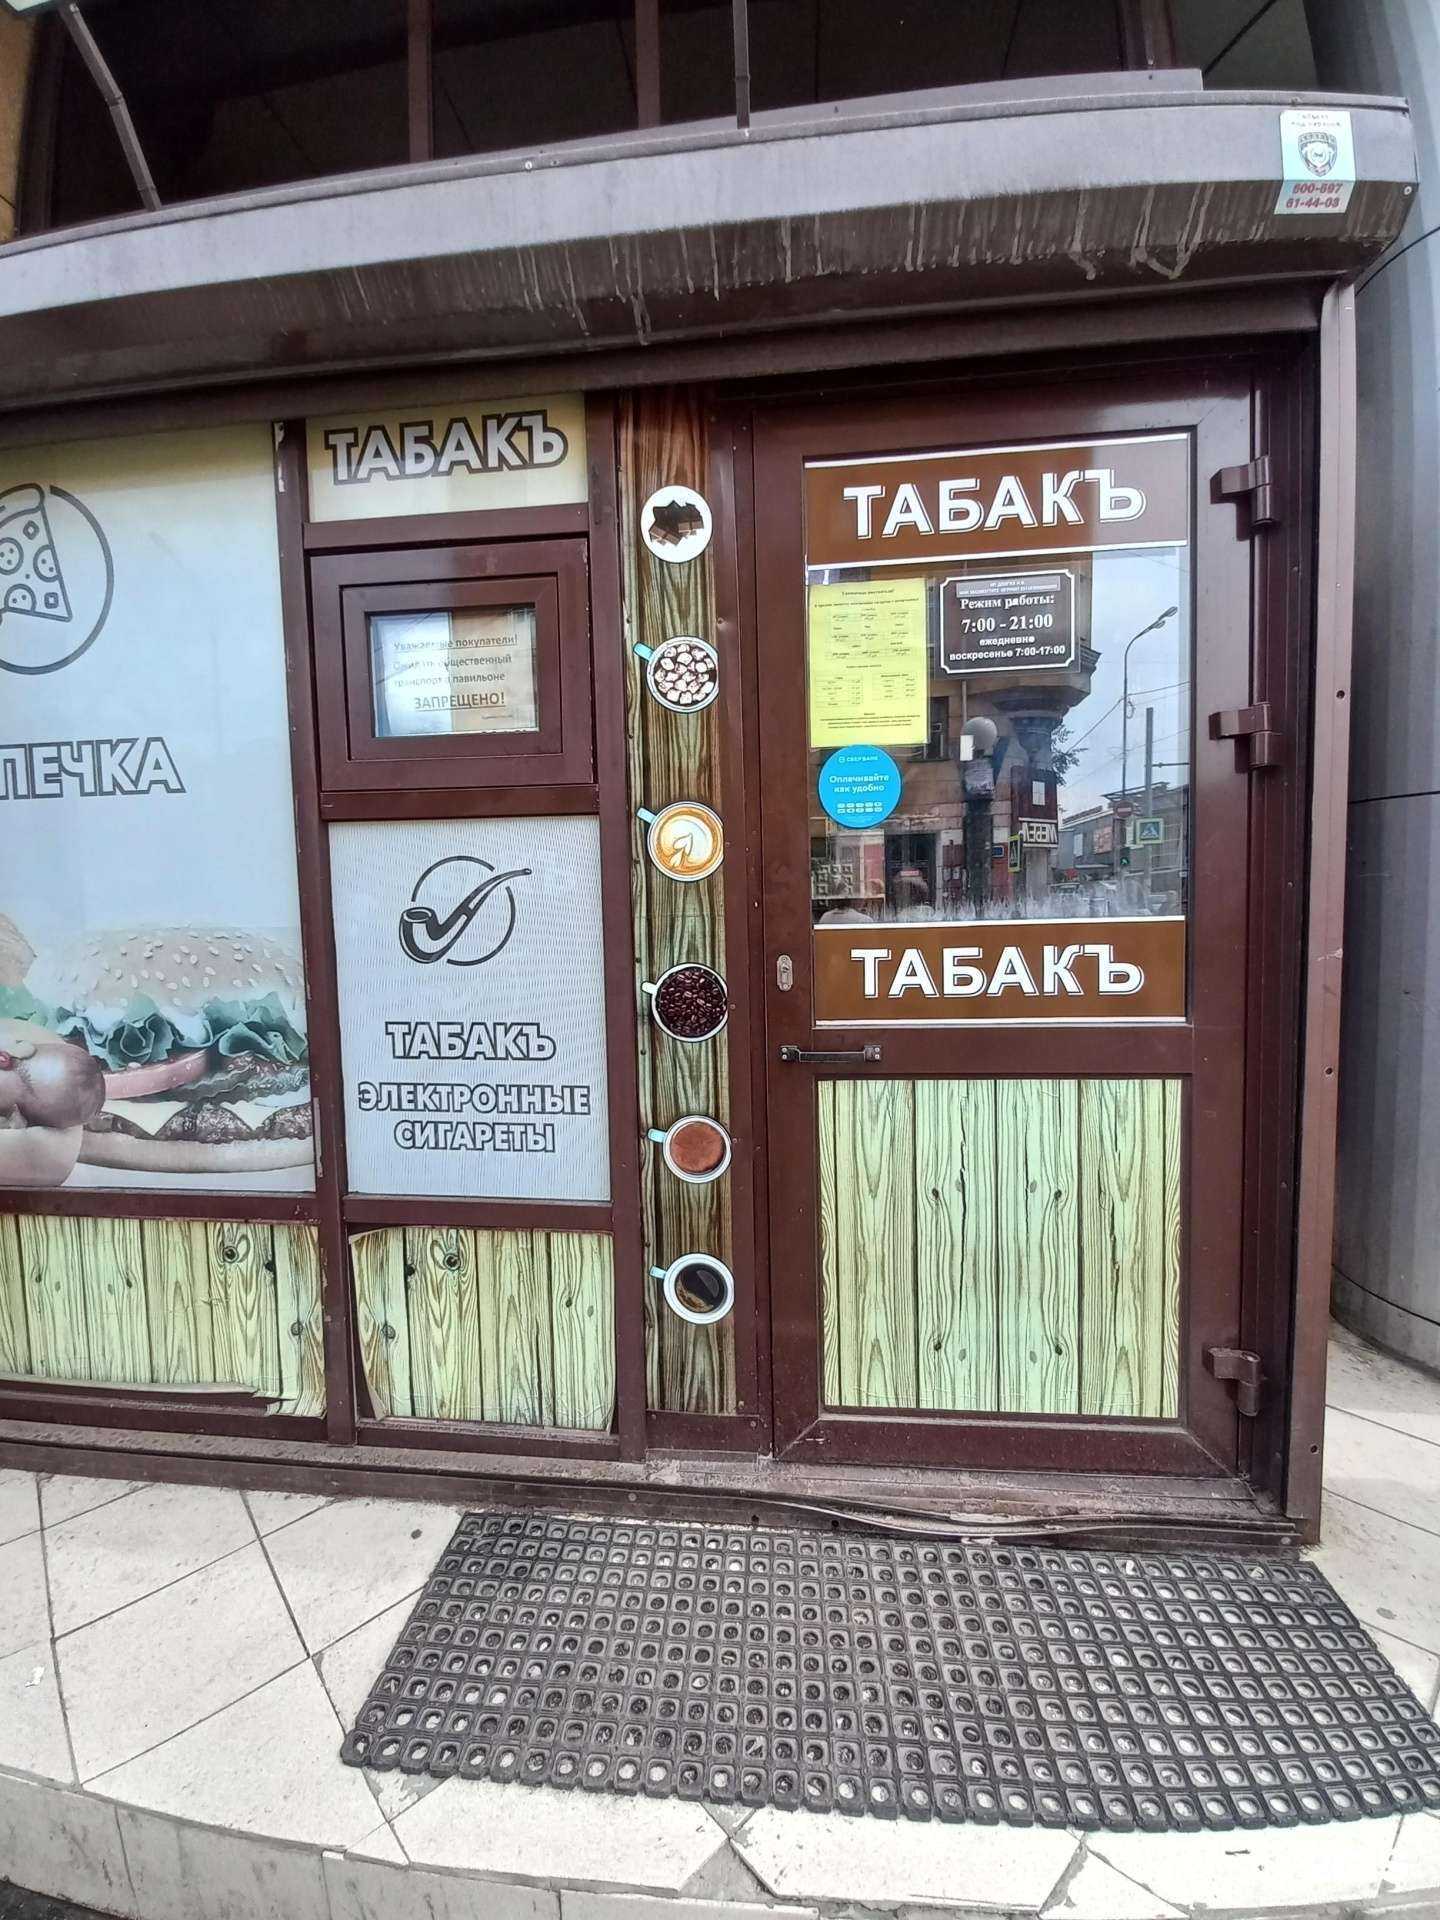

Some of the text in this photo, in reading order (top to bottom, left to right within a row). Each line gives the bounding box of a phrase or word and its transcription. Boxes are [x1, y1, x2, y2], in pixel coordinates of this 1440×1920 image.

[324, 409, 569, 485] ТАБАКЪ
[843, 468, 1147, 540] ТАБАКЪ
[960, 595, 1055, 609] Режим работы:
[962, 617, 995, 633] 7:00
[1009, 614, 1053, 630] 21:00
[455, 634, 518, 648] покупатели!
[979, 635, 1035, 647] ежедневно
[949, 645, 1066, 661] воскресенье 7:00-17:00
[453, 672, 505, 684] павильоне
[415, 691, 505, 709] ЗАПРЕЩЕНО!
[829, 772, 890, 783] Оплачивайте
[852, 784, 885, 793] удобно
[850, 944, 1145, 998] ТАБАКЪ
[385, 1021, 557, 1061] ТАБАКЪ
[358, 1081, 591, 1115] ЭЛЕКТРОННЫЕ
[394, 1120, 556, 1152] СИГАРЕТЫ
